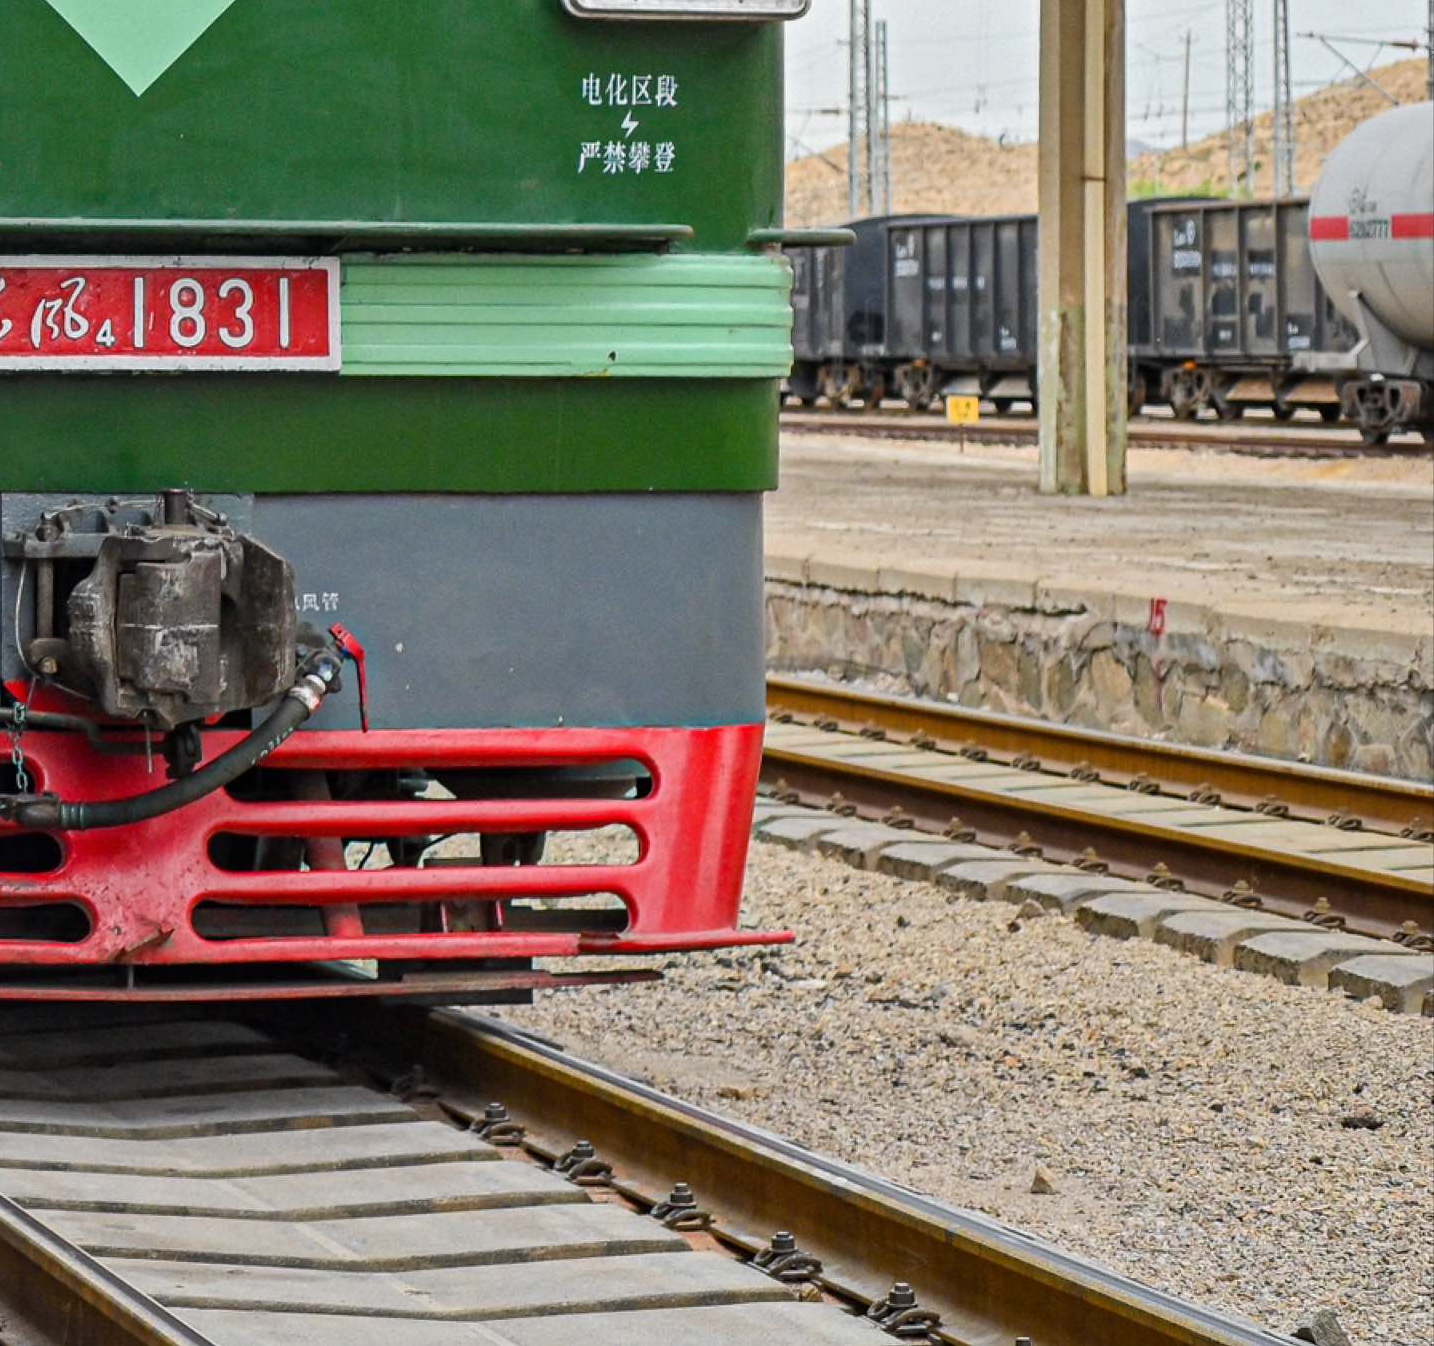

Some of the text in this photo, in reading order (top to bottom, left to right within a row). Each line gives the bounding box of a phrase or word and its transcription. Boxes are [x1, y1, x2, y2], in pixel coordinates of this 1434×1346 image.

[582, 72, 679, 107] 电化区段
[577, 141, 676, 174] 严禁攀登
[134, 277, 291, 349] 1831
[294, 592, 339, 612] 风管
